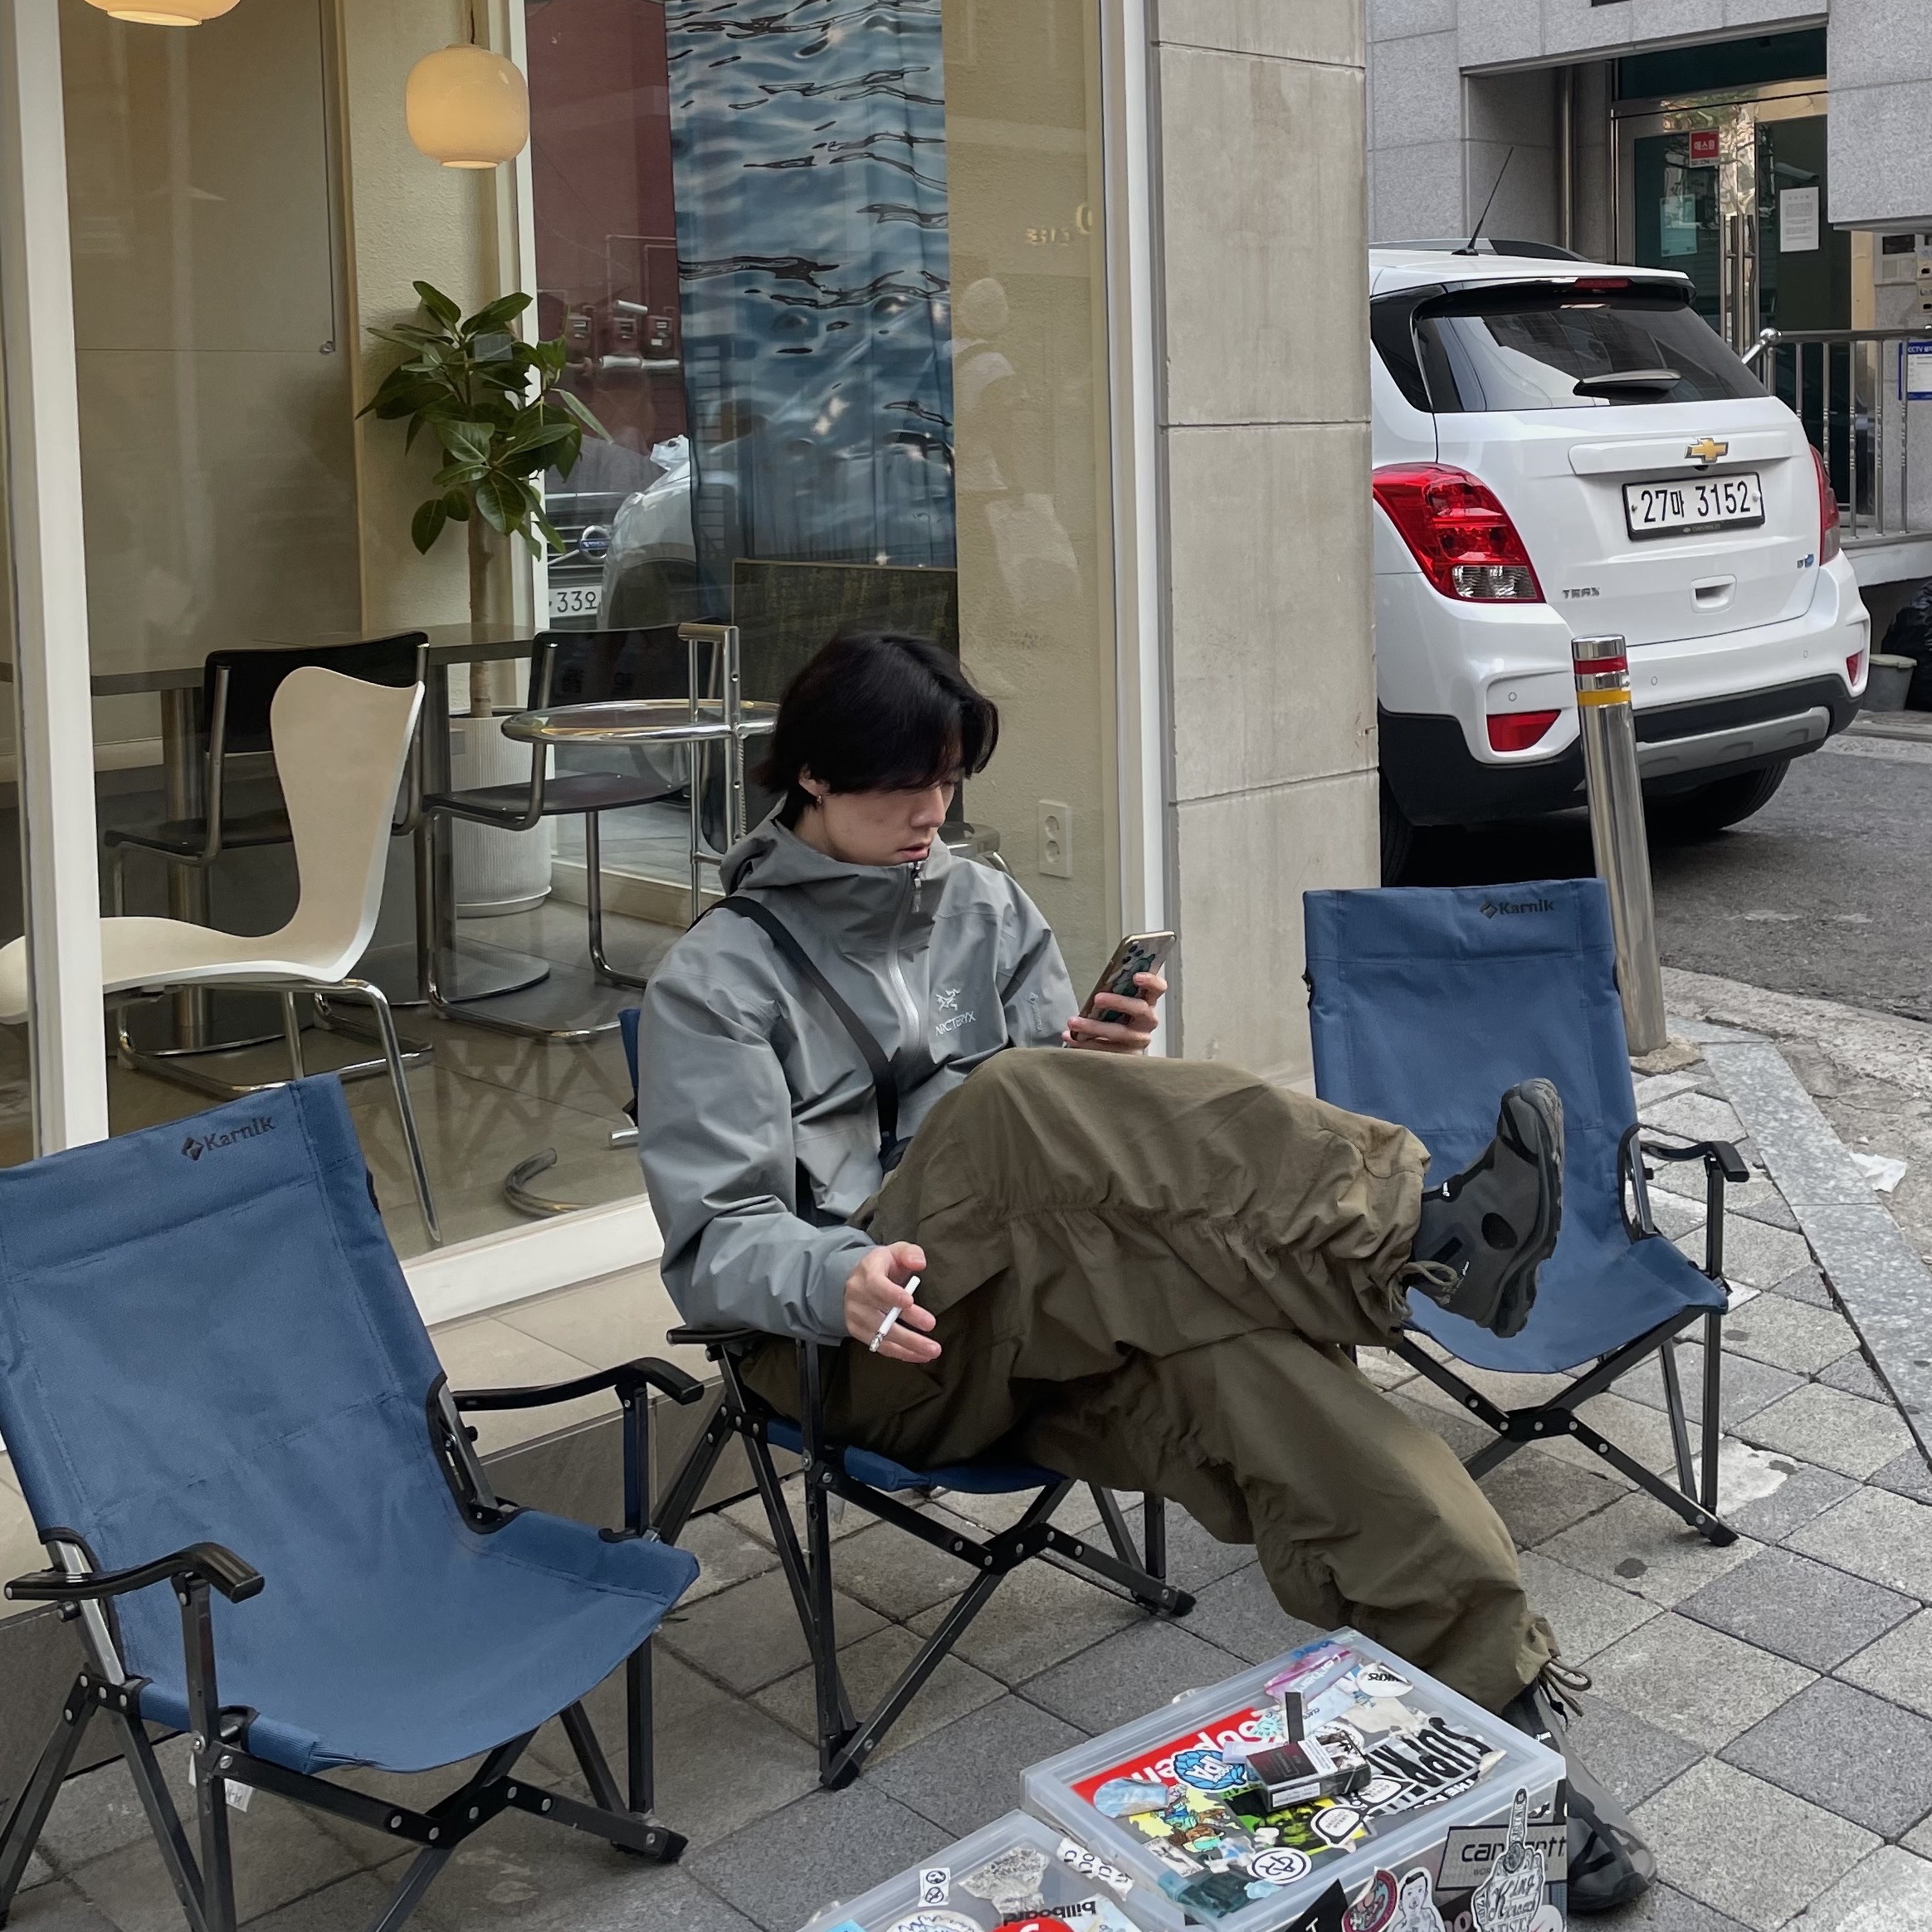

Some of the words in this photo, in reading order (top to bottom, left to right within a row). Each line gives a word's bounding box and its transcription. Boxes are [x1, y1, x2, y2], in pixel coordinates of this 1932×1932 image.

[1641, 489, 1685, 524] 27마
[1695, 480, 1751, 517] 3152
[557, 590, 598, 613] 33오
[1184, 1754, 1227, 1783] IPA
[1003, 1900, 1097, 1927] billboard
